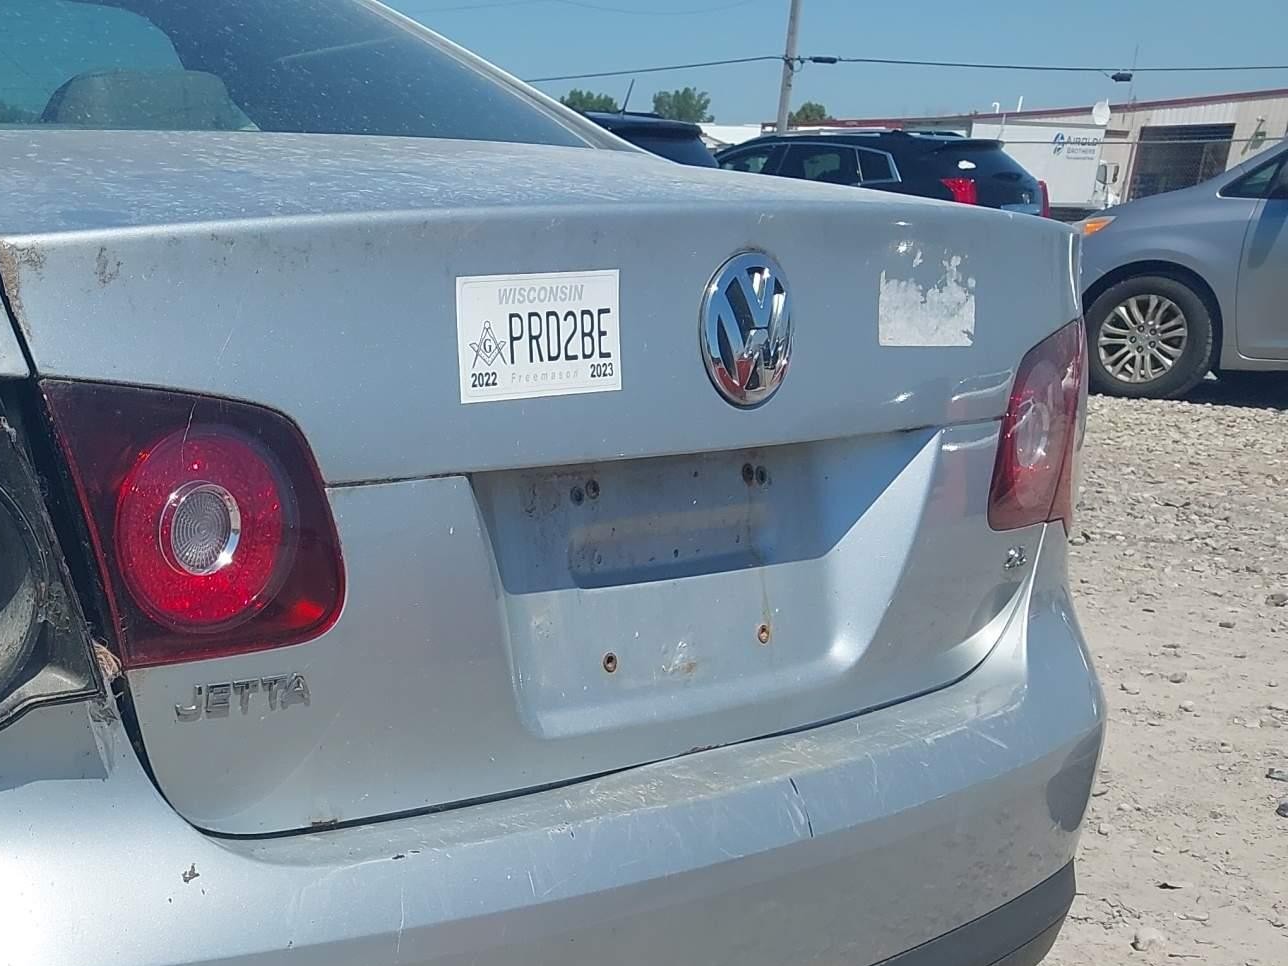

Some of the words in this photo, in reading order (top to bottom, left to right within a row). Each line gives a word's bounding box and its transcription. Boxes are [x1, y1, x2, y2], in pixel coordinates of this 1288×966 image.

[498, 284, 584, 305] WISCONSIN
[509, 308, 612, 365] PRD2BE
[471, 372, 499, 389] 2022
[511, 370, 579, 384] Freemason
[590, 363, 614, 379] 2023
[174, 672, 312, 721] JETTA
